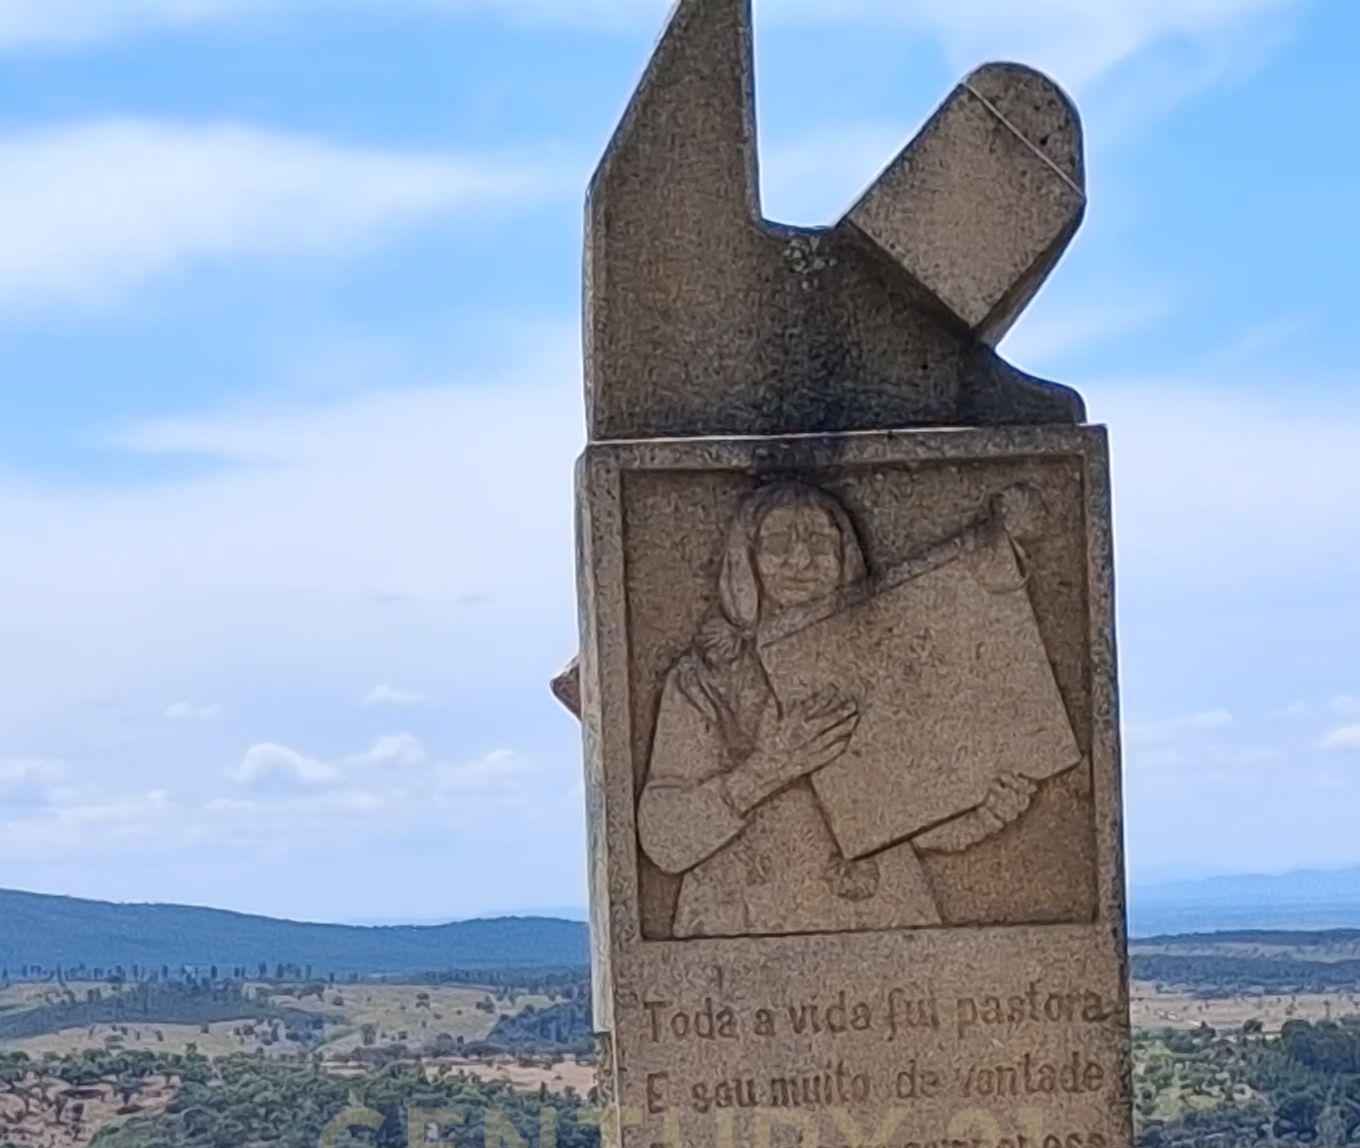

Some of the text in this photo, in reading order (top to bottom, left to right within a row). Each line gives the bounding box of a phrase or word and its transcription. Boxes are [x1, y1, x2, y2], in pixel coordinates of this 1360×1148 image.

[643, 997, 739, 1043] Toda
[753, 1008, 776, 1036] a
[790, 990, 872, 1035] vida
[957, 980, 1113, 1040] pastora
[646, 1052, 1105, 1114] E sou muito de vontade
